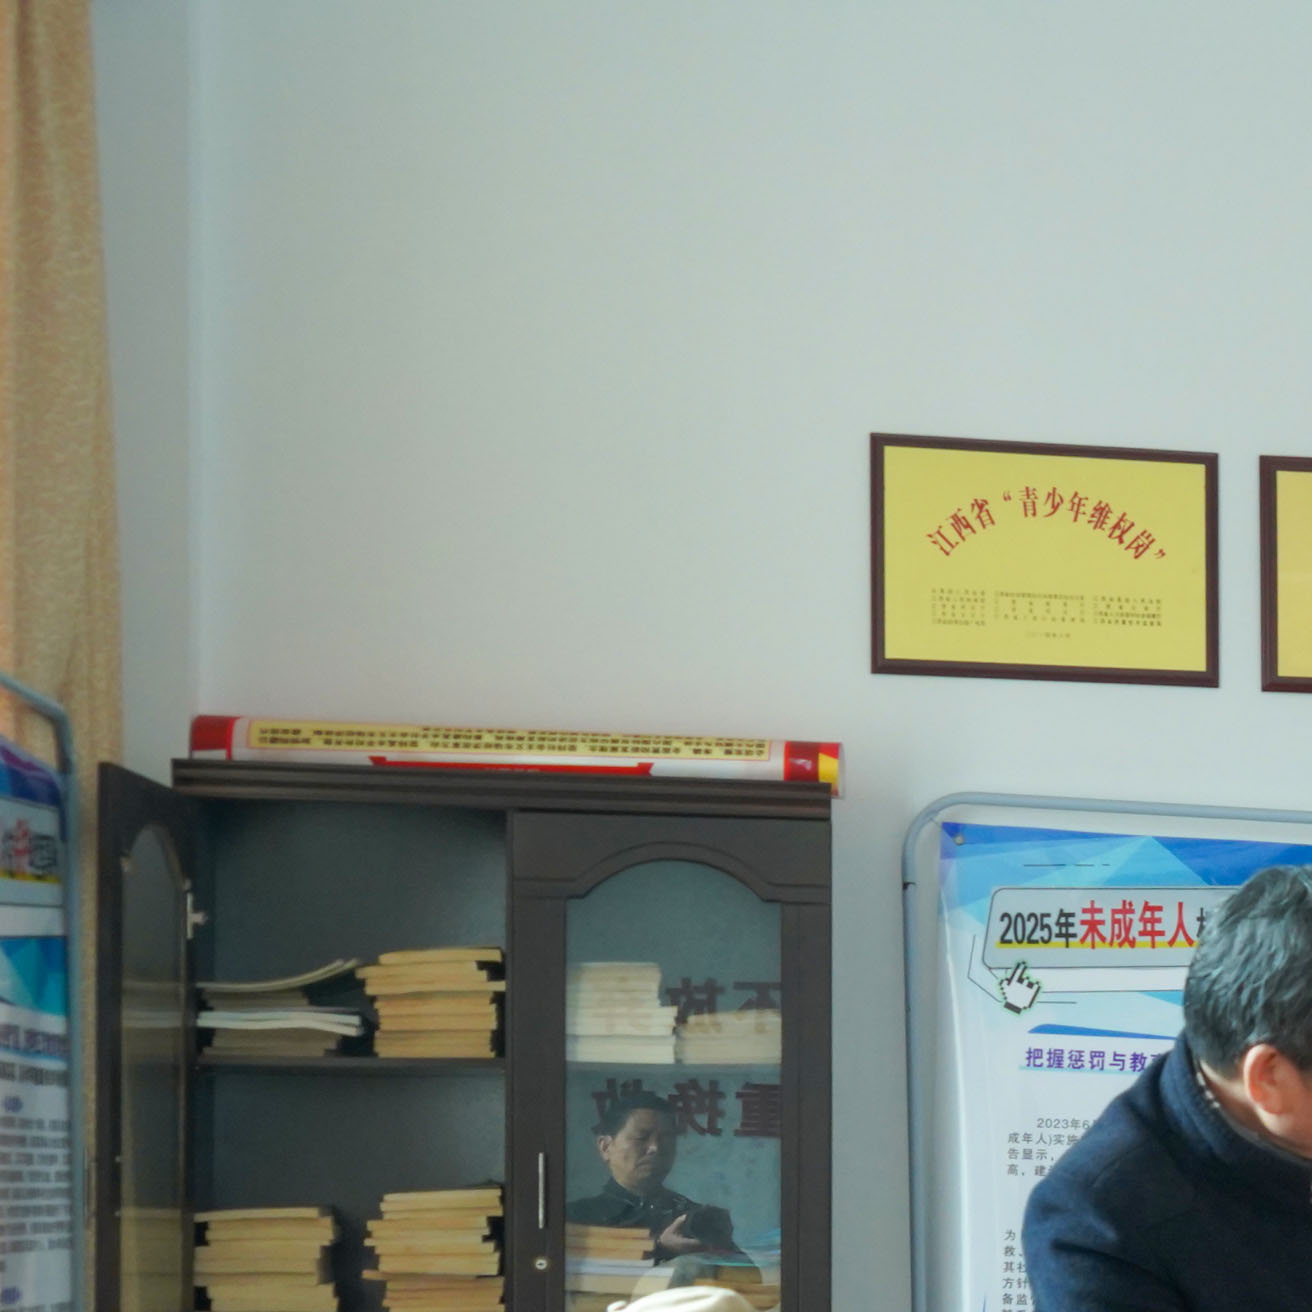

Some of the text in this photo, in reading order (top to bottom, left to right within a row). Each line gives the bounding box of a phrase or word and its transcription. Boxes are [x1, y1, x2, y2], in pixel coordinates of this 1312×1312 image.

[925, 486, 1167, 560] 江西省“青少年维权岗”
[999, 899, 1206, 950] 2025年未成年人
[1025, 1046, 1163, 1073] 把握惩罚与教
[1036, 1117, 1097, 1130] 2023年6
